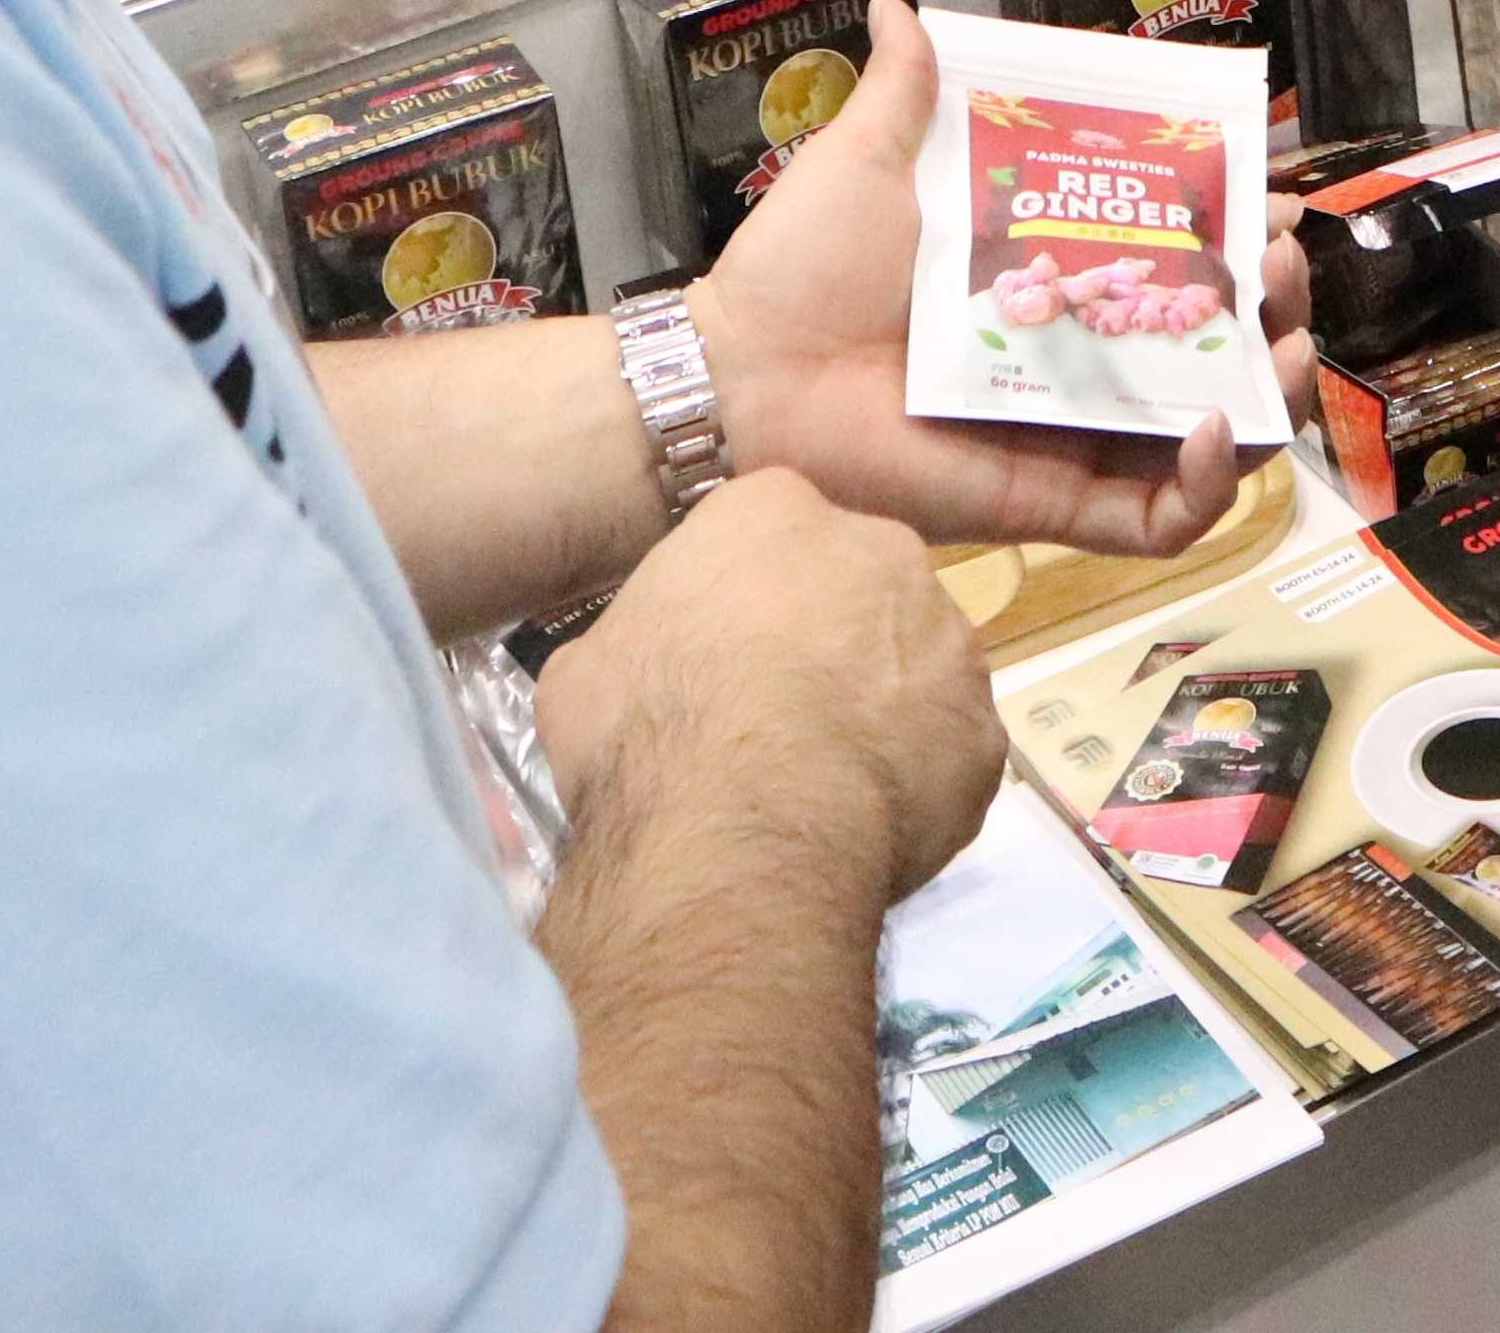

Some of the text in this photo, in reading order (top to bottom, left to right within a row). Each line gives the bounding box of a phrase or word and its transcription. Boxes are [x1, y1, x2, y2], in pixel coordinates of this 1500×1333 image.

[687, 21, 777, 81] KOPI
[363, 94, 423, 125] KOPI
[1026, 149, 1176, 177] PADMA SWEETIES
[304, 139, 548, 244] KOPI BUBUK
[1057, 169, 1147, 200] RED
[1011, 190, 1193, 233] GINGER
[400, 283, 496, 331] BENUA
[1012, 381, 1051, 394] gram
[1275, 572, 1312, 594] BOOTH
[1304, 596, 1340, 619] BOOTH
[1192, 729, 1241, 741] BENUA
[897, 1193, 962, 1237] Memproduksi
[897, 1237, 936, 1267] Sesuai
[929, 1221, 973, 1252] Kriteria
